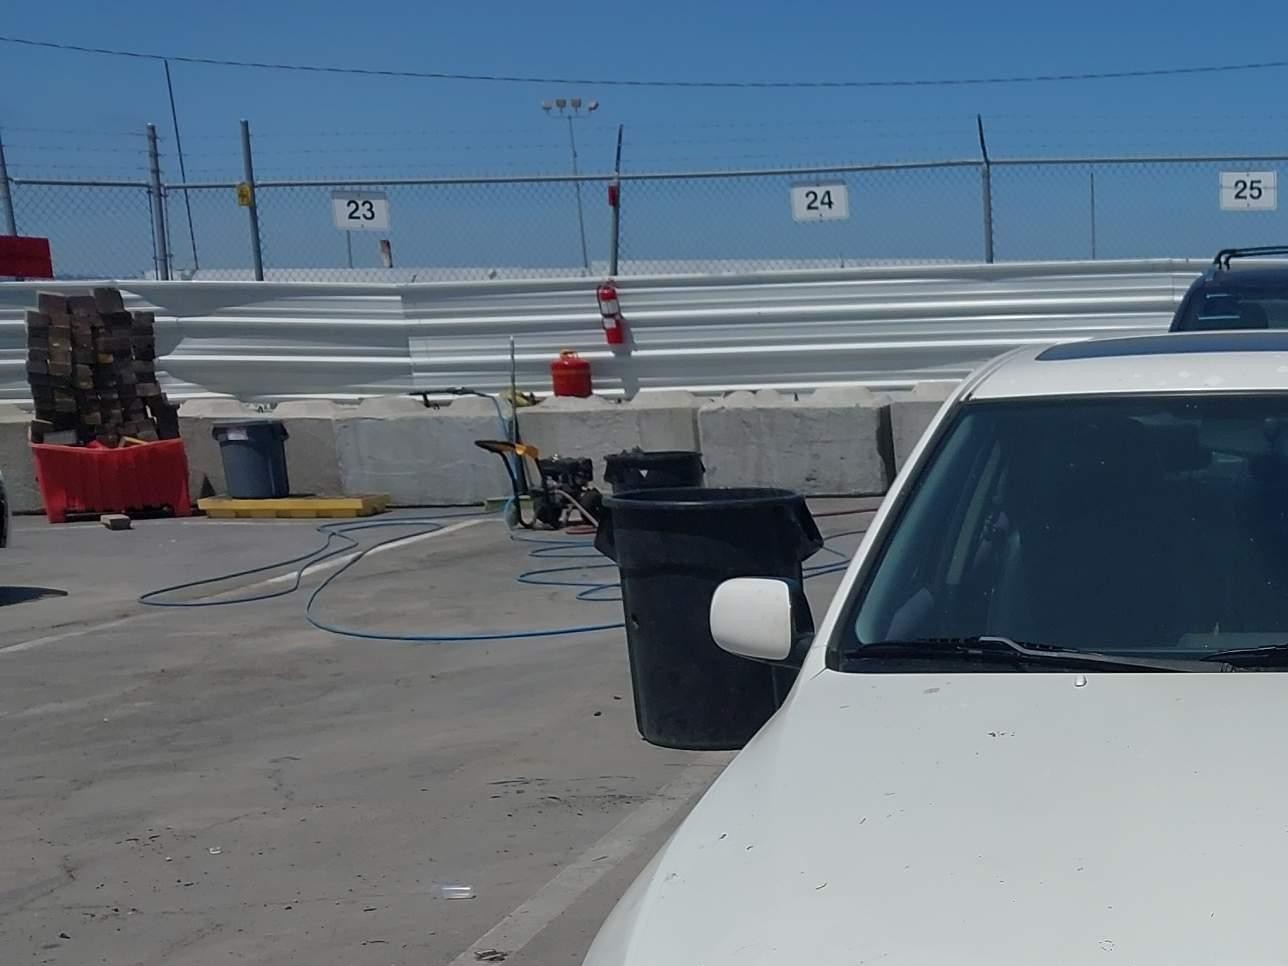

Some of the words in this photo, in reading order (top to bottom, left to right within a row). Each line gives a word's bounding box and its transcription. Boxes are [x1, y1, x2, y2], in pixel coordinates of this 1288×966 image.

[1233, 179, 1263, 200] 25
[346, 200, 376, 220] 23
[805, 190, 834, 210] 24
